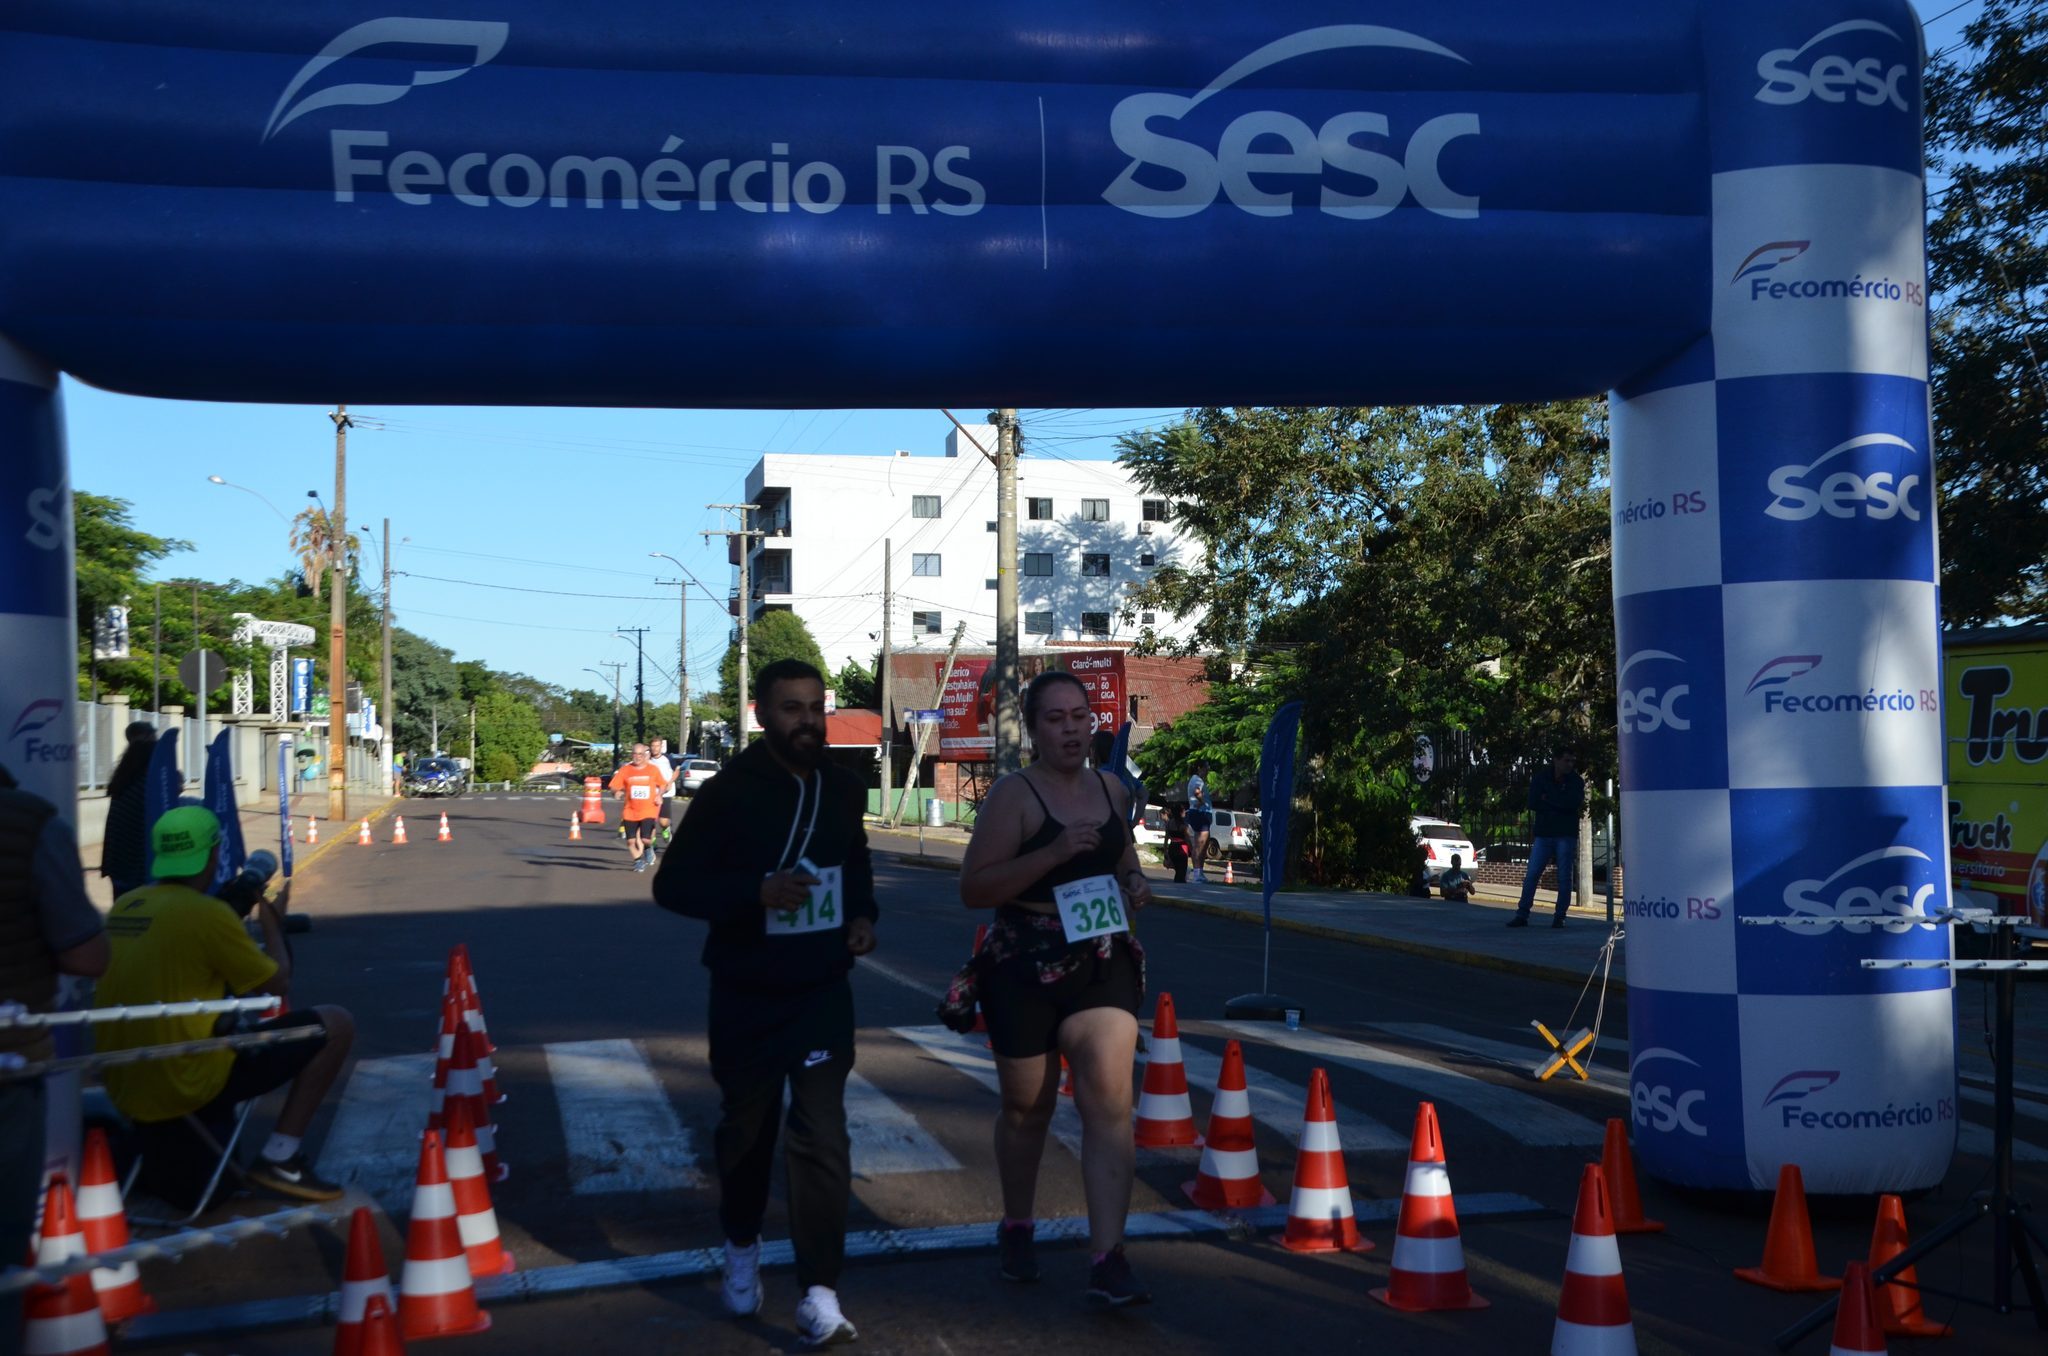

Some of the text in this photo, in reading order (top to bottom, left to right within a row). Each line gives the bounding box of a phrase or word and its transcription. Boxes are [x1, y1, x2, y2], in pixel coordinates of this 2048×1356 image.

[1754, 48, 1908, 112] Sesc
[1101, 92, 1481, 220] Sesc
[331, 130, 987, 217] Fecomércio RS
[1752, 274, 1924, 307] Fecomércio RS
[1673, 490, 1707, 516] RS
[1763, 463, 1921, 522] Sesc
[939, 666, 970, 677] Fderico
[944, 679, 979, 691] estphalen,
[1101, 681, 1109, 690] 60
[941, 692, 955, 703] laro
[1101, 691, 1115, 699] GIGA
[1618, 684, 1691, 734] esc
[1764, 688, 1938, 714] Fecomércio RS
[1071, 896, 1122, 933] 326
[1686, 897, 1722, 920] RS
[1782, 878, 1938, 936] Sesc
[1631, 1081, 1708, 1136] esc
[1782, 1096, 1955, 1130] Fecomércio RS
